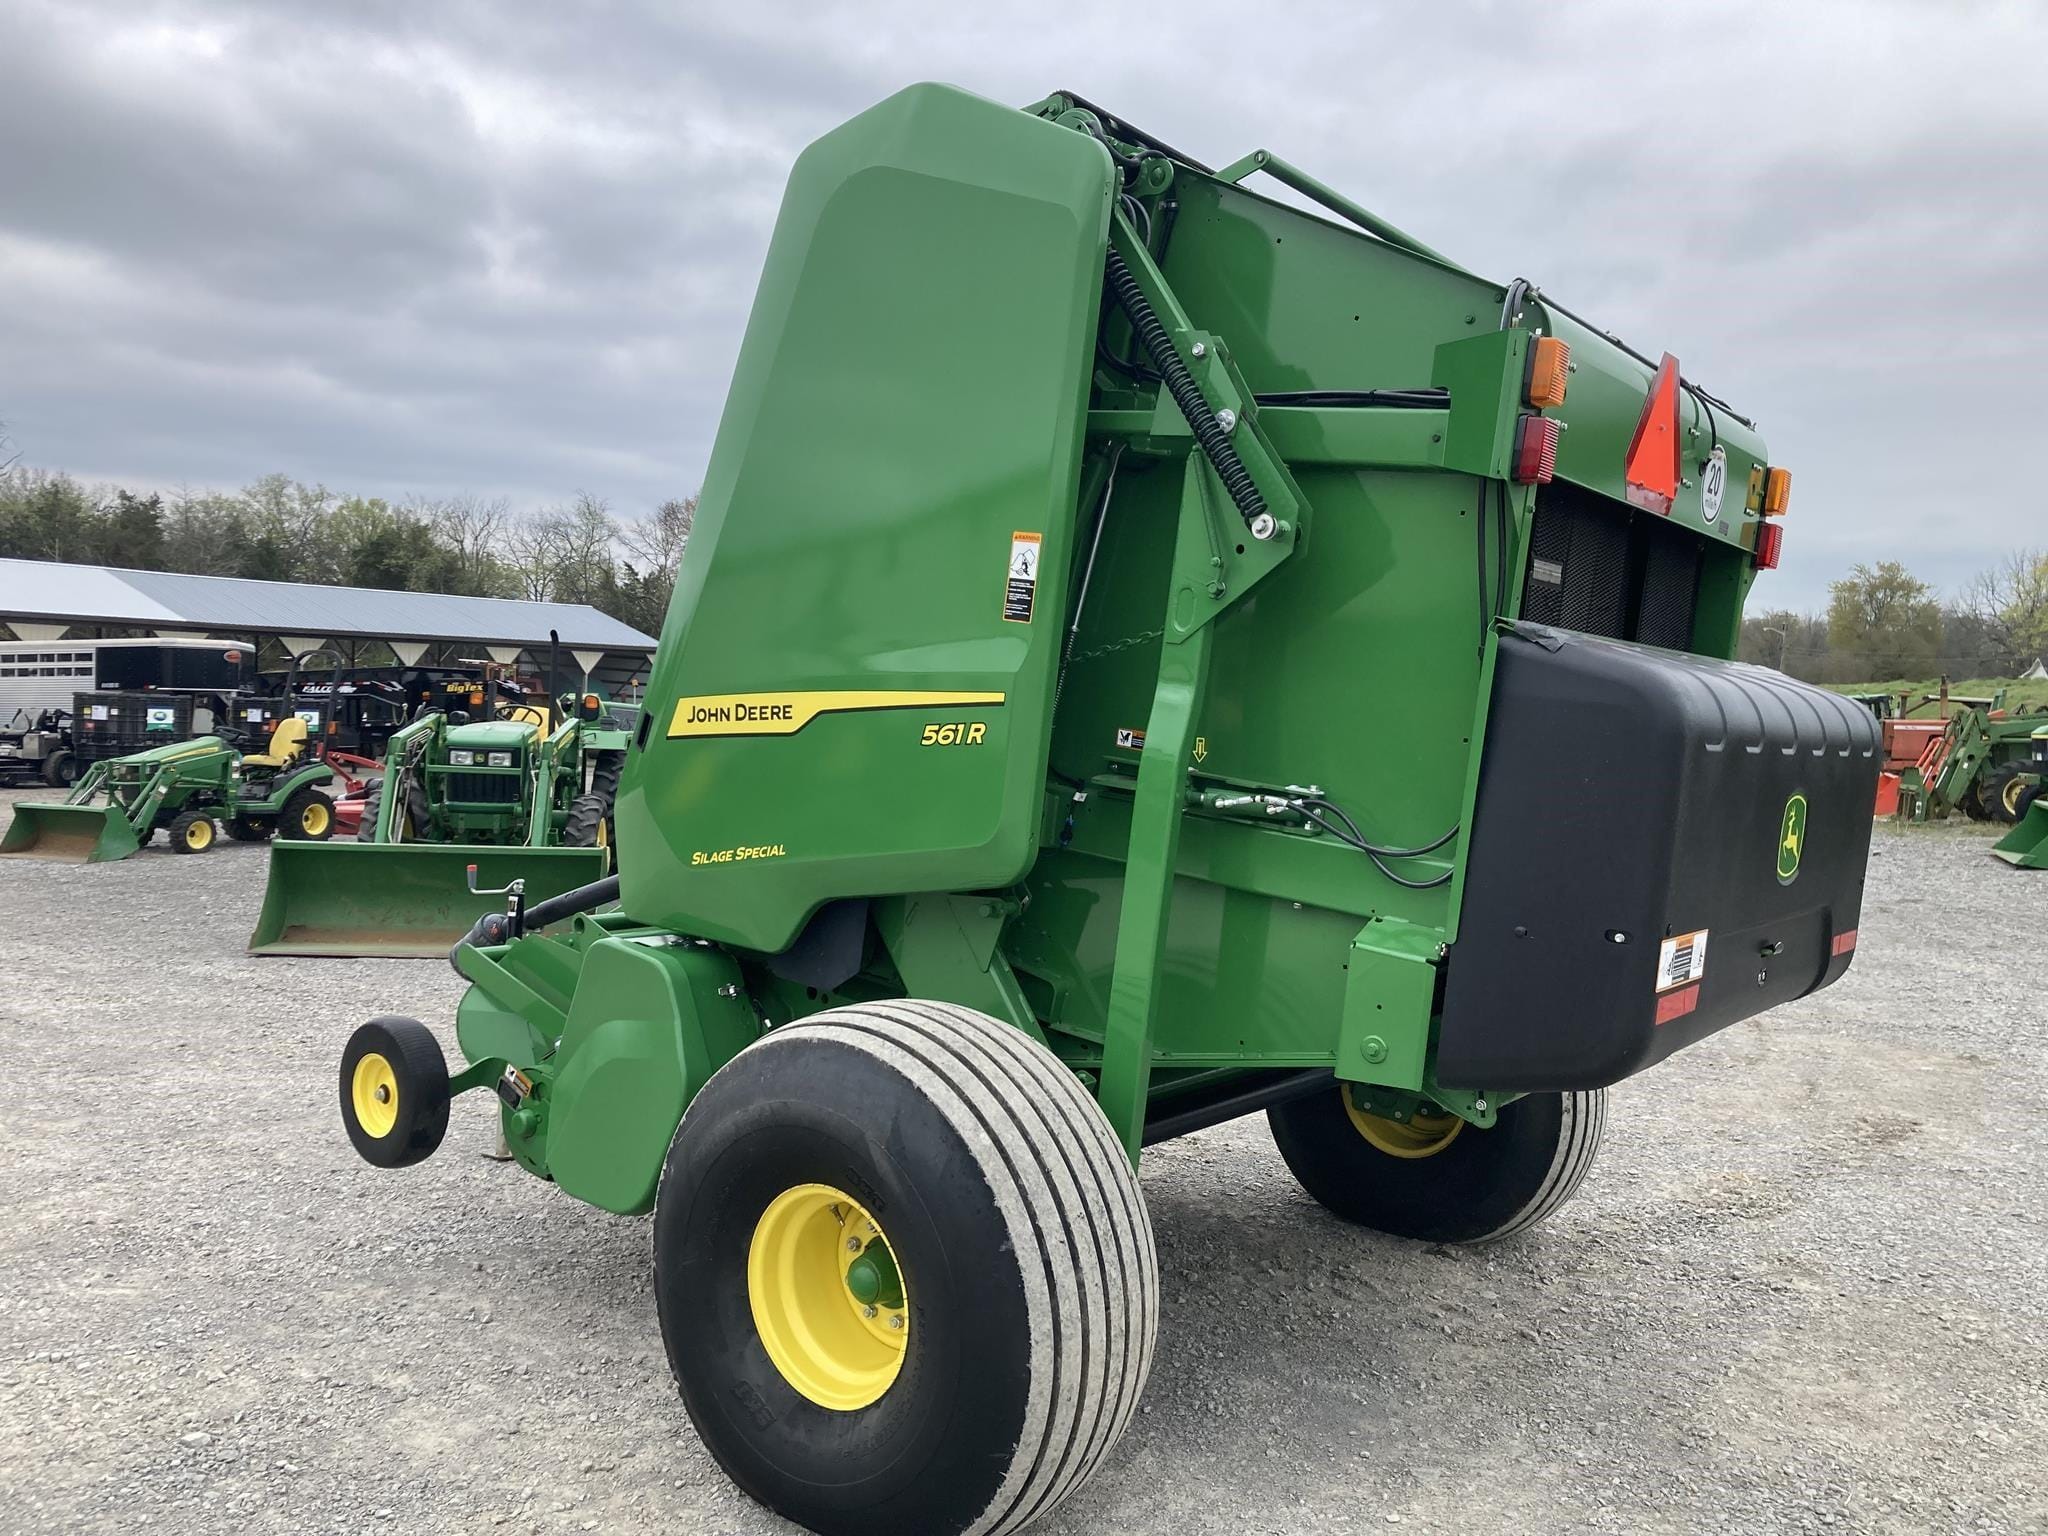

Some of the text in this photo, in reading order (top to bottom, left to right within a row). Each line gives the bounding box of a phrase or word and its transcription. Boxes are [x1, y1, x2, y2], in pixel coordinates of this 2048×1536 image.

[1707, 464, 1722, 496] 20
[687, 704, 793, 723] JOHN DEERE
[691, 844, 785, 865] SILAGE SPECIAL
